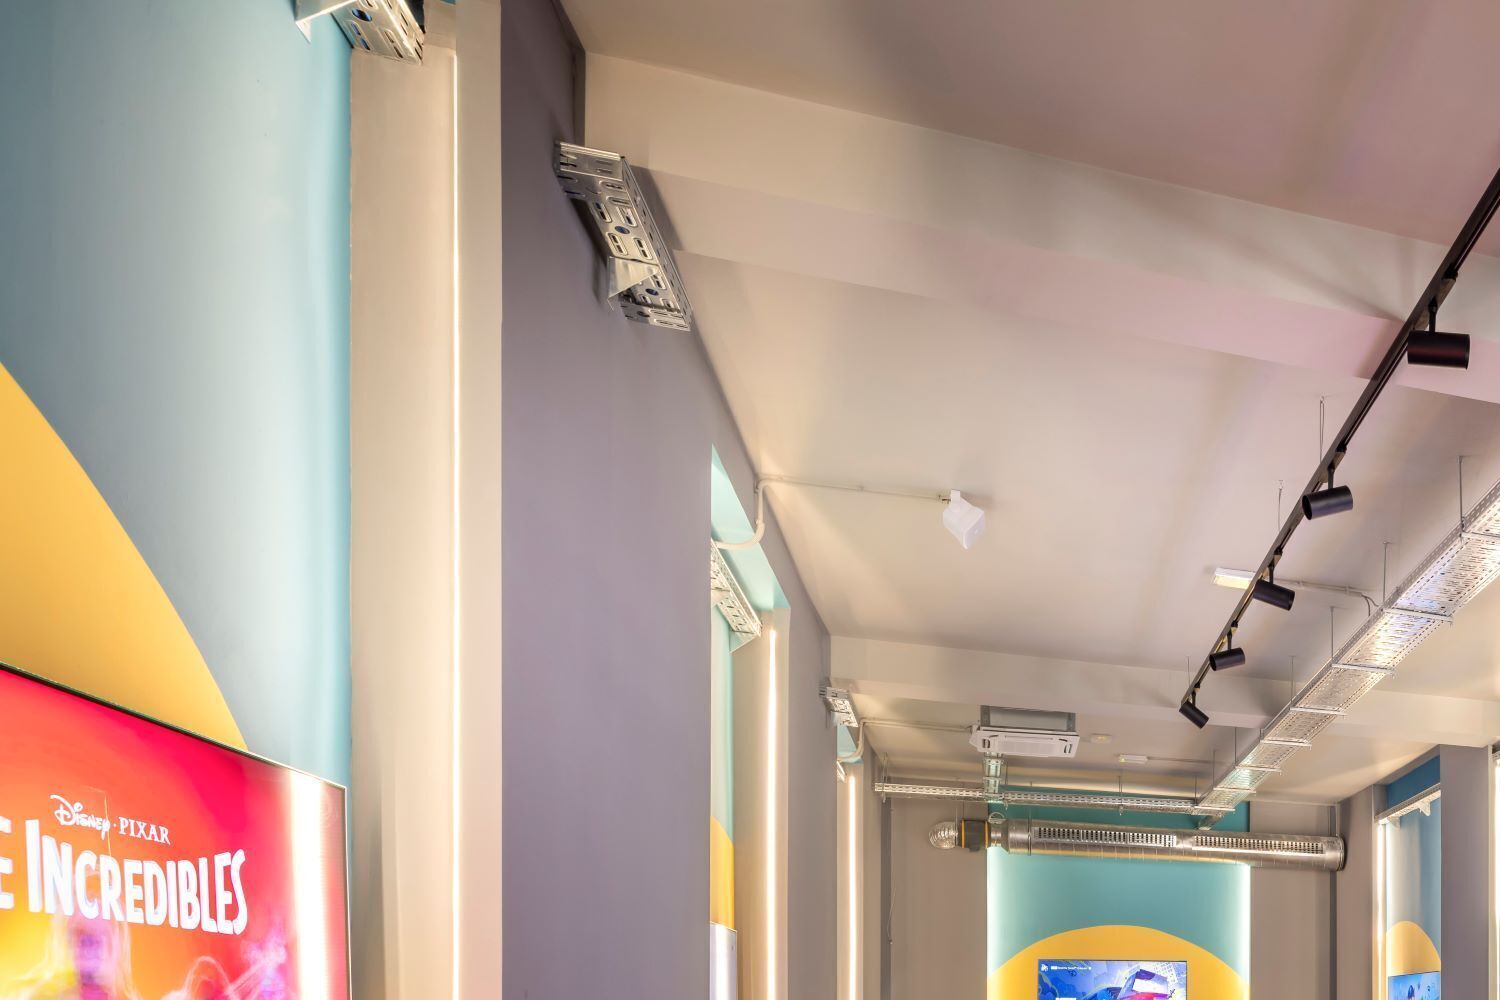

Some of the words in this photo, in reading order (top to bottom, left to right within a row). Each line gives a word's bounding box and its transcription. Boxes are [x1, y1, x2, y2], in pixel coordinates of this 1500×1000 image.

[50, 794, 110, 840] Disney
[118, 816, 171, 846] PIXAR
[25, 818, 248, 936] INCREDIBLES
